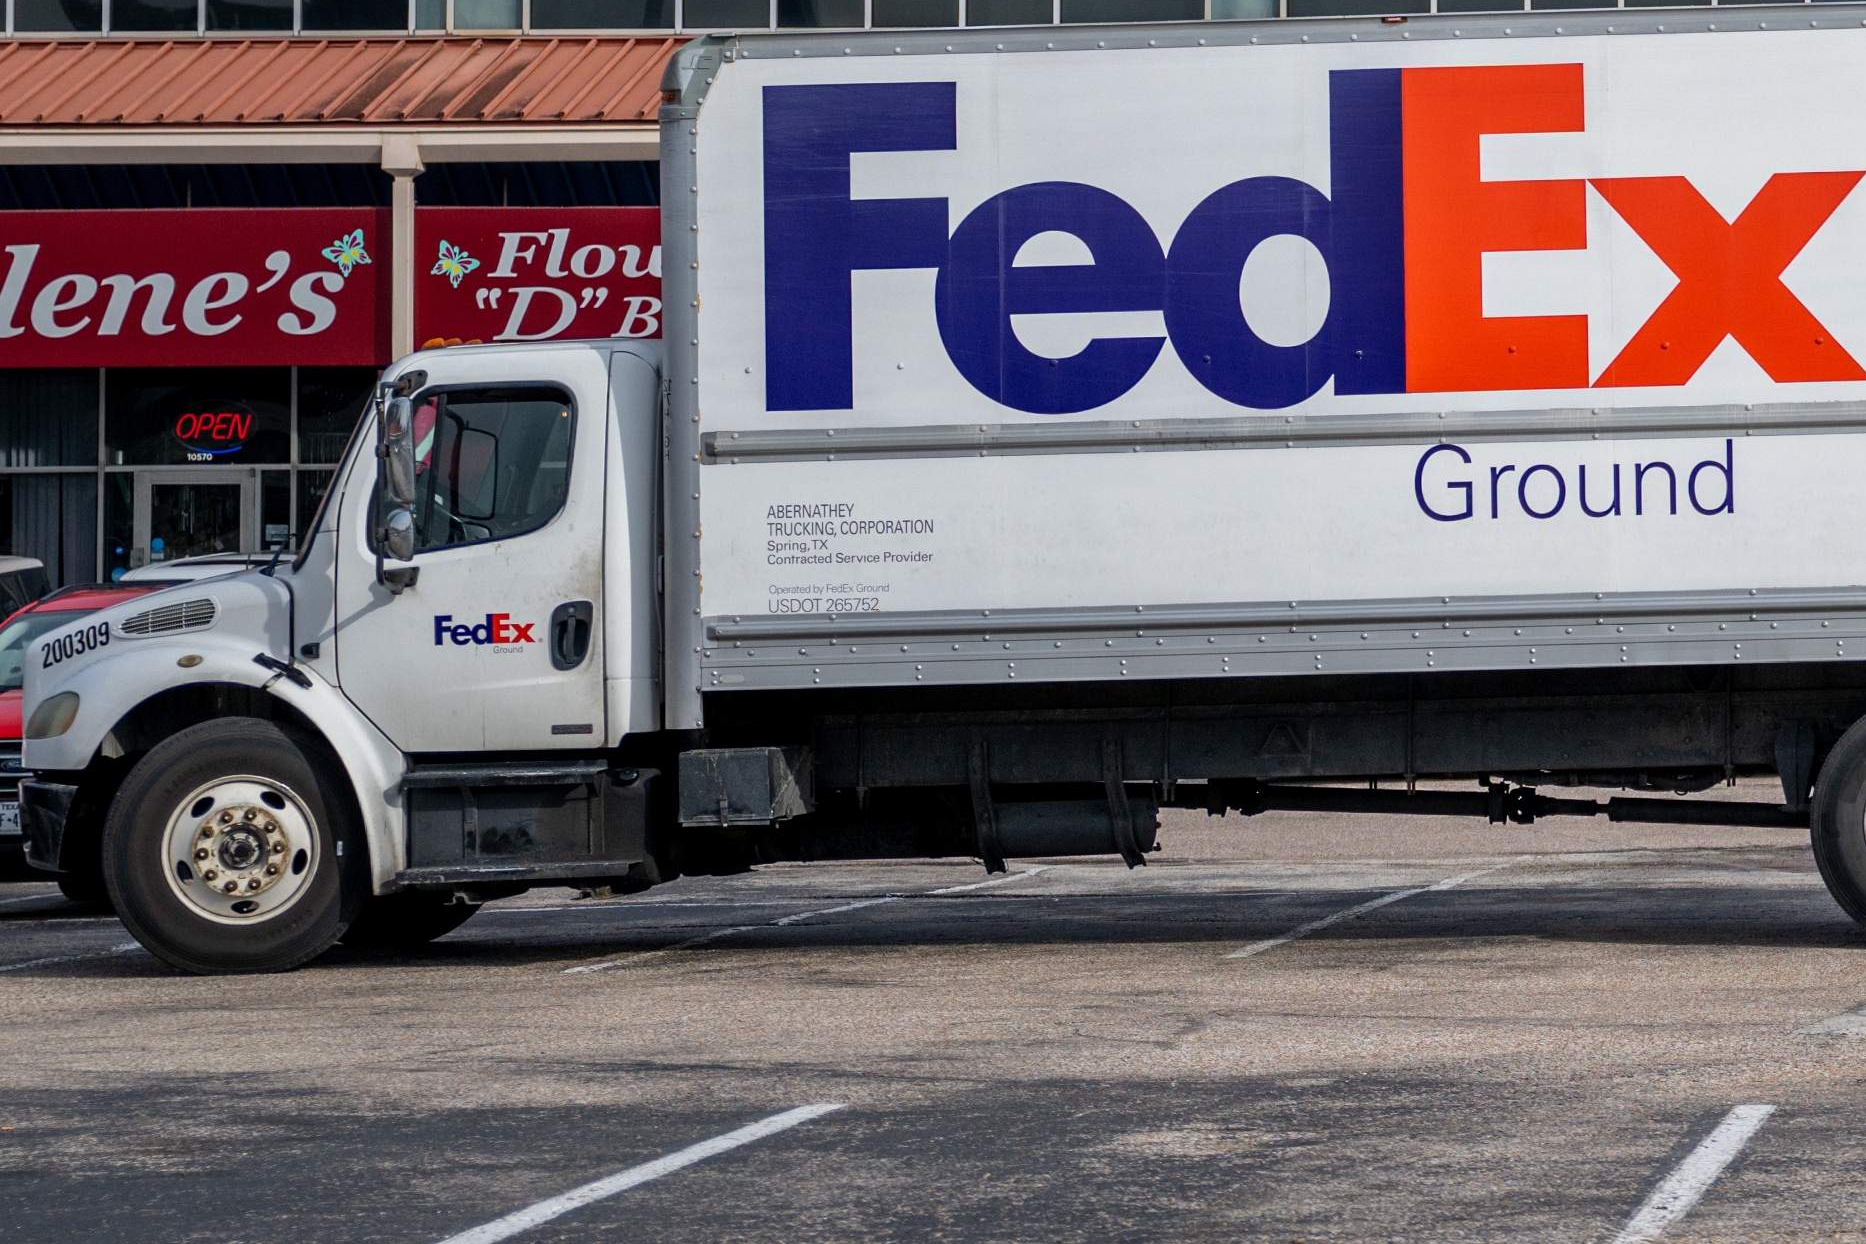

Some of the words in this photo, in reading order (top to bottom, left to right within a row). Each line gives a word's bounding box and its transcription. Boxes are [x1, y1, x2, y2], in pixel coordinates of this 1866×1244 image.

[175, 412, 252, 441] OPEN
[186, 452, 213, 462] 10570
[1414, 439, 1736, 523] Ground
[767, 504, 854, 519] ABERNATHEY
[767, 522, 838, 537] TRUCKING,
[840, 520, 934, 535] CORPORATION
[767, 554, 833, 565] Contracted
[835, 553, 881, 564] Service
[883, 552, 934, 563] Provider
[768, 584, 811, 595] Operated
[812, 585, 824, 596] by
[826, 583, 854, 594] FedEx
[856, 583, 890, 593] Ground
[768, 599, 823, 614] USDOT
[825, 597, 880, 613] 265752
[434, 613, 536, 645] FedEx
[41, 621, 110, 669] 200309
[492, 645, 524, 654] Ground
